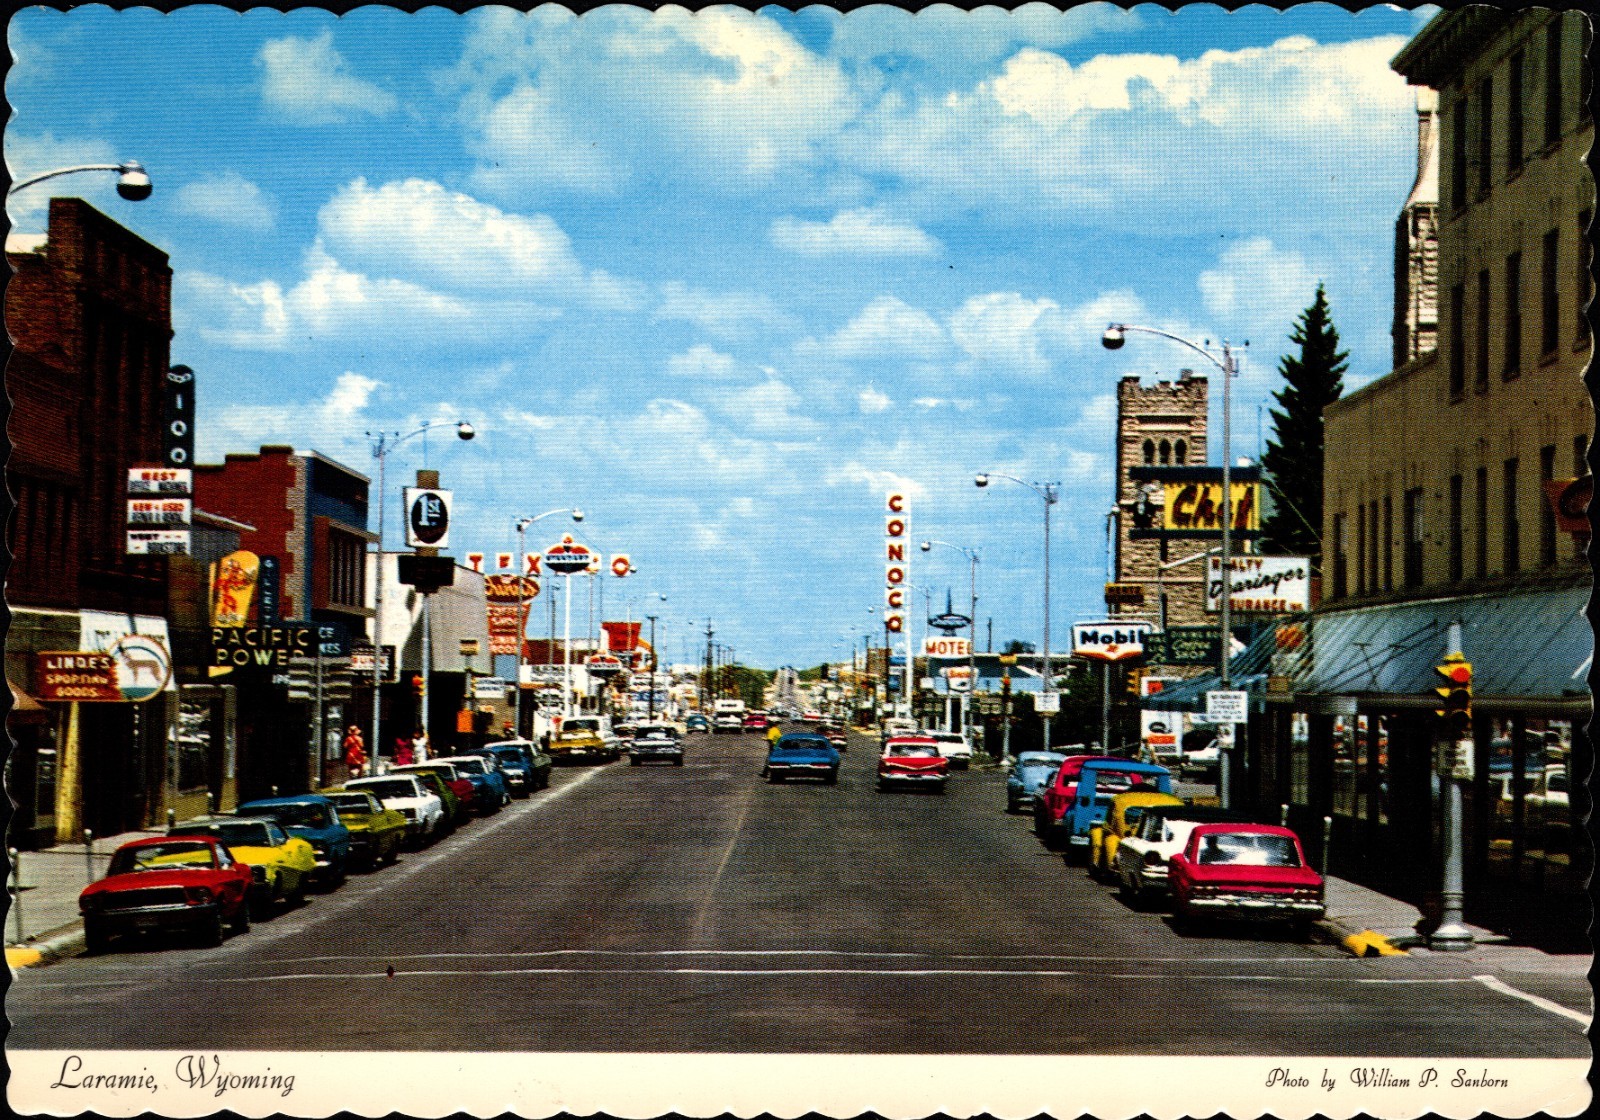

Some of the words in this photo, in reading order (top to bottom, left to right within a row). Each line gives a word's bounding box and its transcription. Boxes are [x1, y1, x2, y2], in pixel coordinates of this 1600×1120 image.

[469, 555, 630, 576] TEXO
[888, 495, 904, 632] CONOCO
[1212, 558, 1263, 571] RALTY
[1215, 598, 1287, 611] ISURANCE
[212, 629, 309, 646] PACIFIC
[1080, 630, 1144, 645] Mobil
